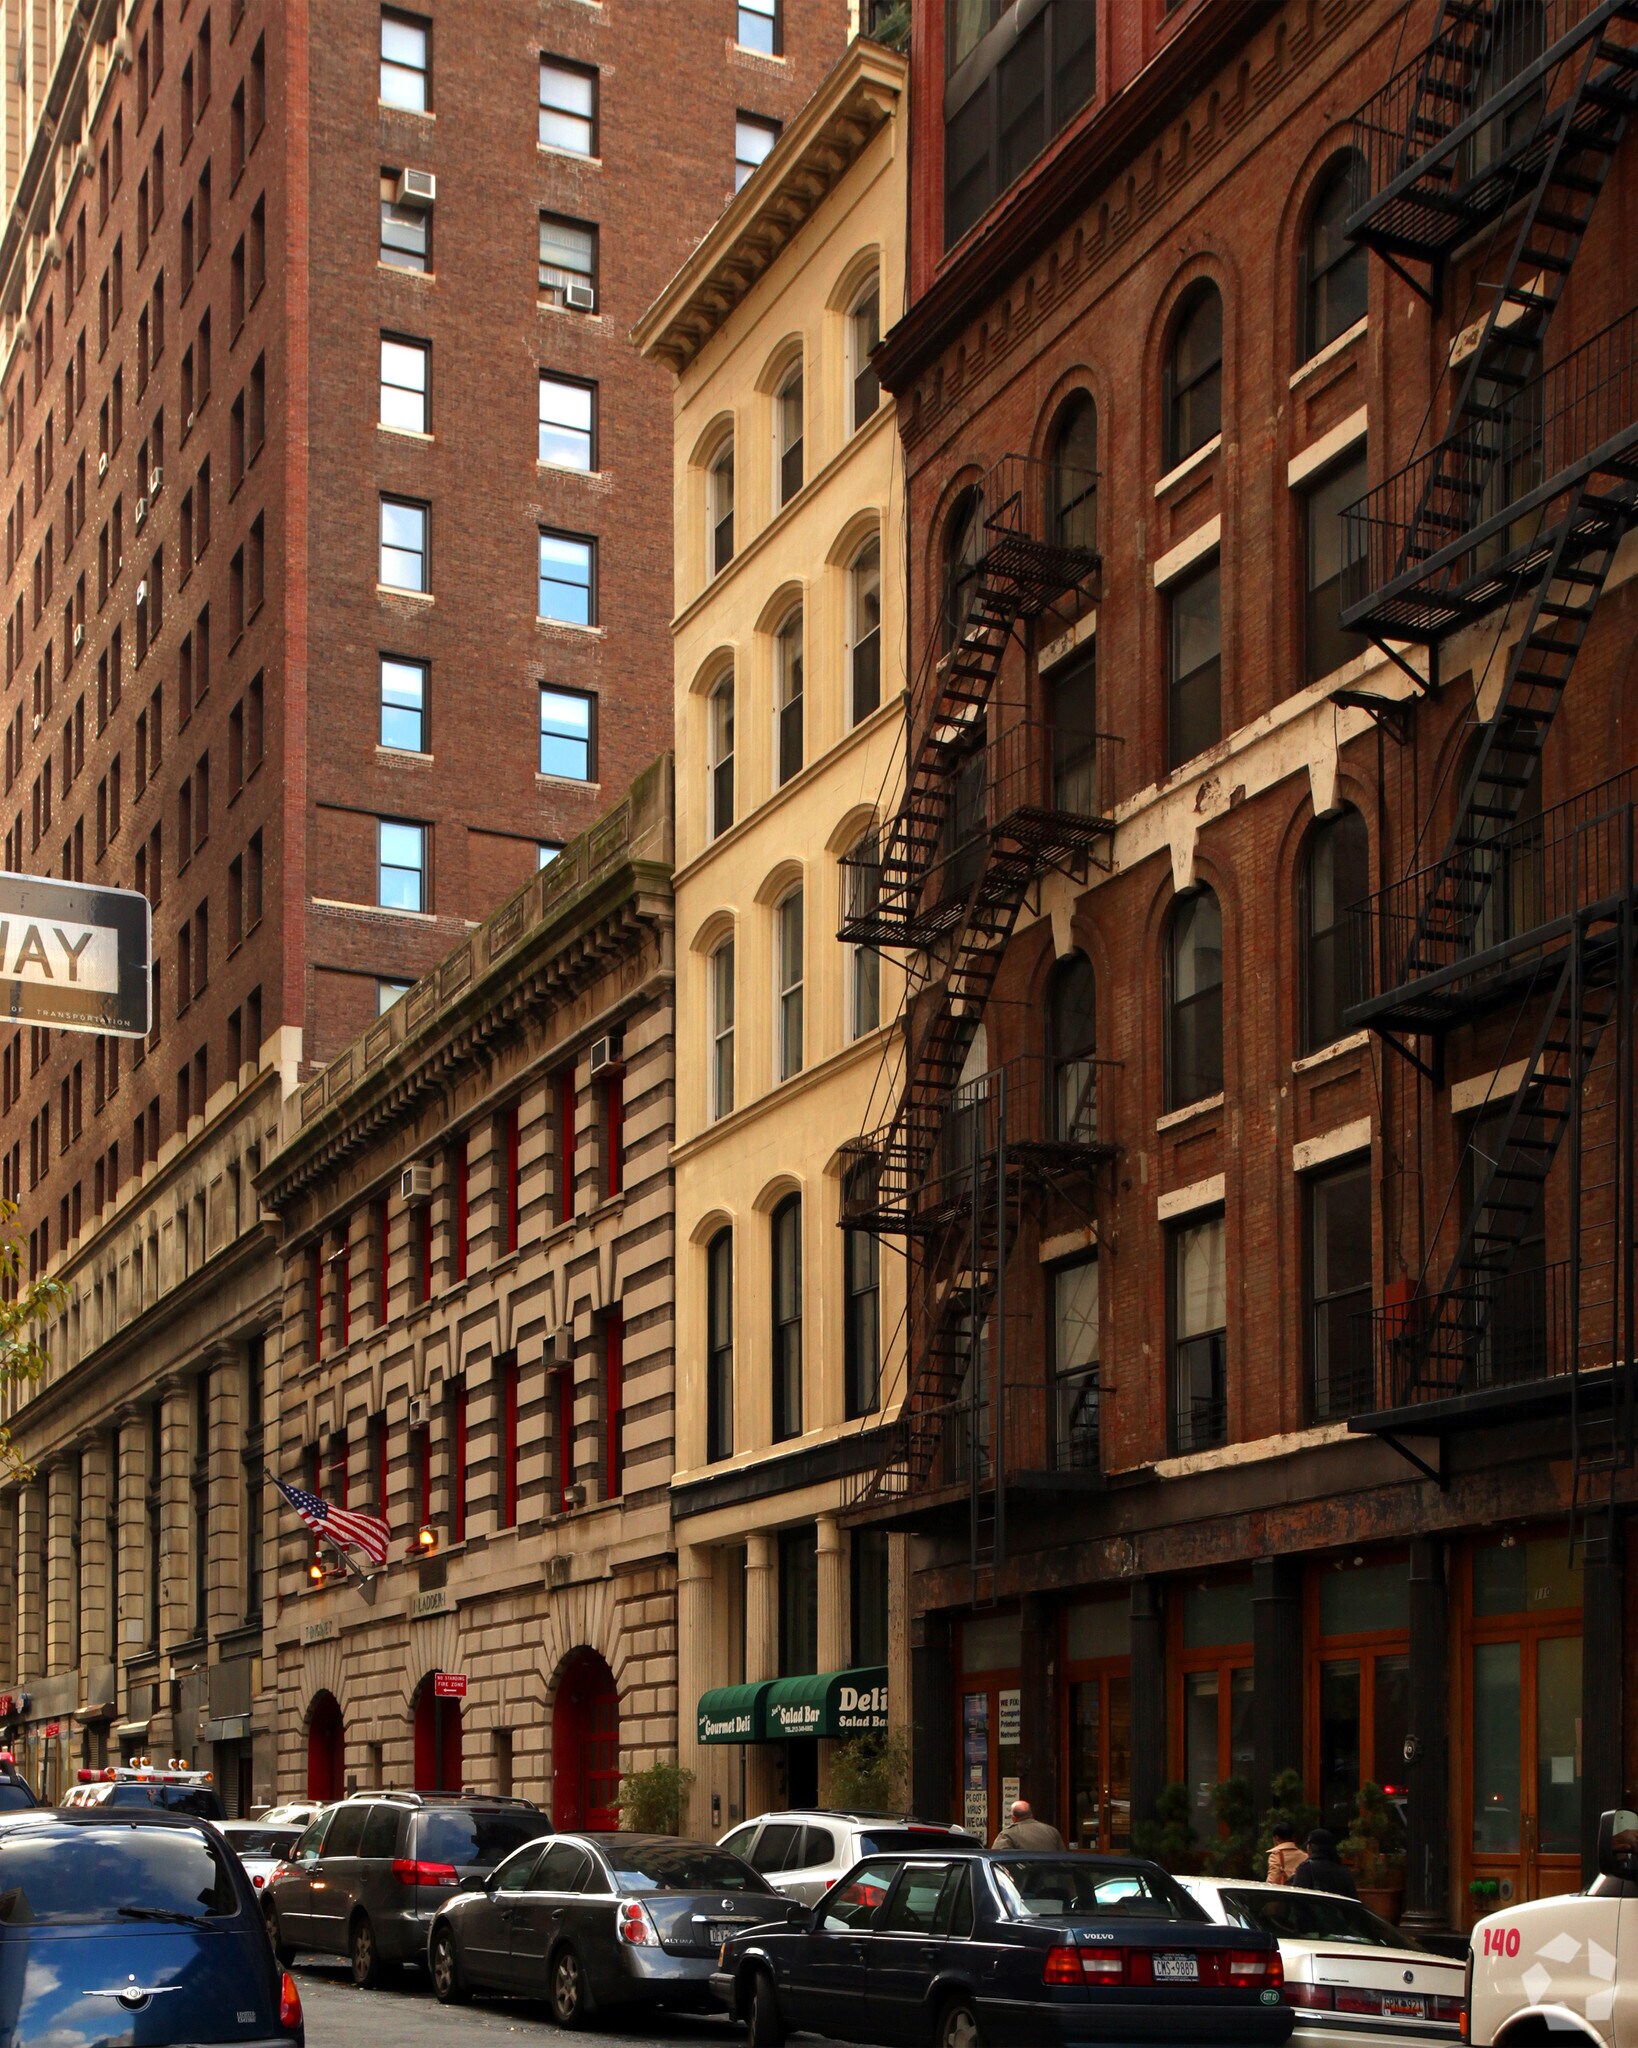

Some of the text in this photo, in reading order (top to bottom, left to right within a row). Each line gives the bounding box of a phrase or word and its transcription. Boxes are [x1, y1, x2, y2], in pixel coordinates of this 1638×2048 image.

[0, 920, 93, 982] AY
[11, 1005, 131, 1027] OF TRANSPORTATION
[1535, 1585, 1552, 1600] 110
[839, 1687, 888, 1712] Deli
[705, 1715, 751, 1736] Gourmet Deli
[780, 1705, 820, 1725] Salad Bar
[839, 1715, 870, 1727] Salad
[1484, 1928, 1520, 1957] 140
